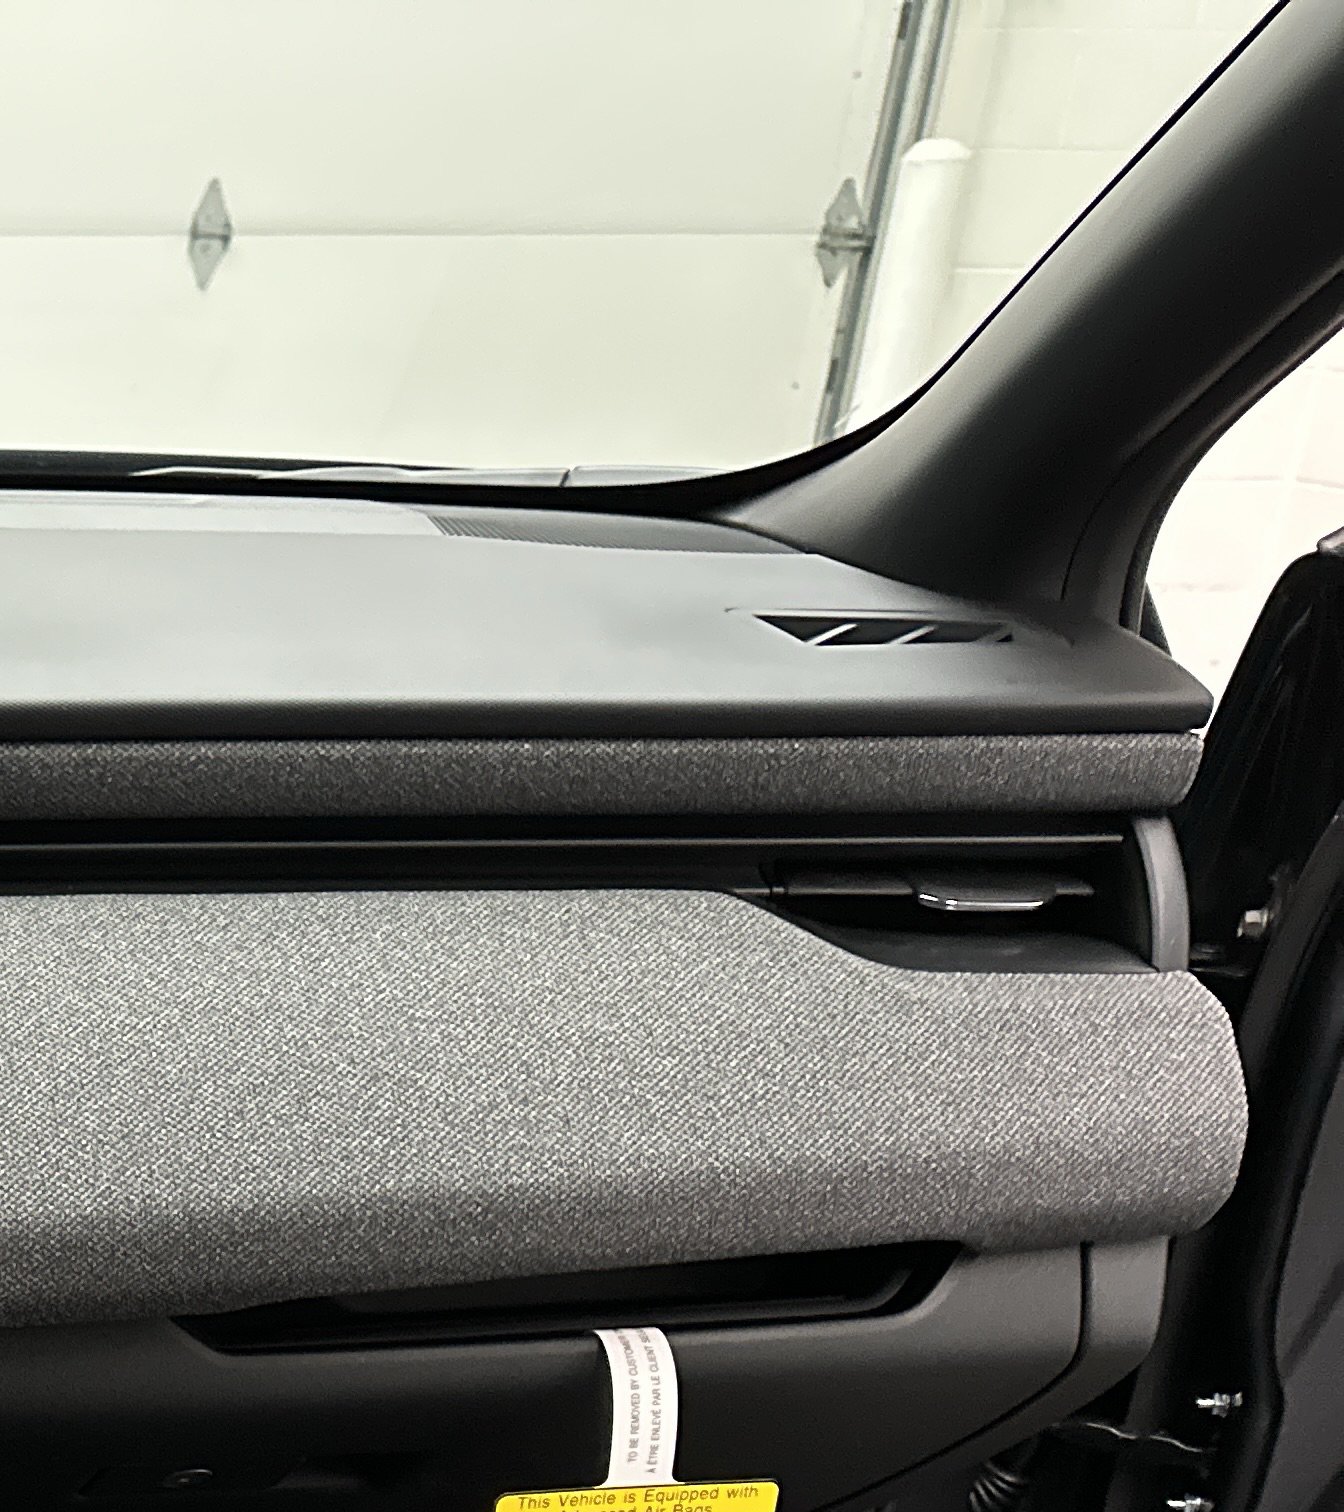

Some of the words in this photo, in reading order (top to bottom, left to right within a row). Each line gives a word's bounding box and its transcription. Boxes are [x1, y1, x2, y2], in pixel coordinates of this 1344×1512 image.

[618, 1335, 638, 1376] CUSTOMER
[645, 1346, 659, 1372] CLIENT
[629, 1379, 640, 1390] BY
[651, 1376, 660, 1386] LE
[652, 1388, 661, 1406] PAR
[630, 1393, 640, 1434] REMOVED
[629, 1438, 639, 1449] BE
[627, 1451, 639, 1463] TO
[518, 1496, 551, 1511] This
[558, 1492, 616, 1508] Vehicle
[623, 1491, 636, 1504] is
[644, 1487, 720, 1505] Equipped
[727, 1485, 759, 1499] with
